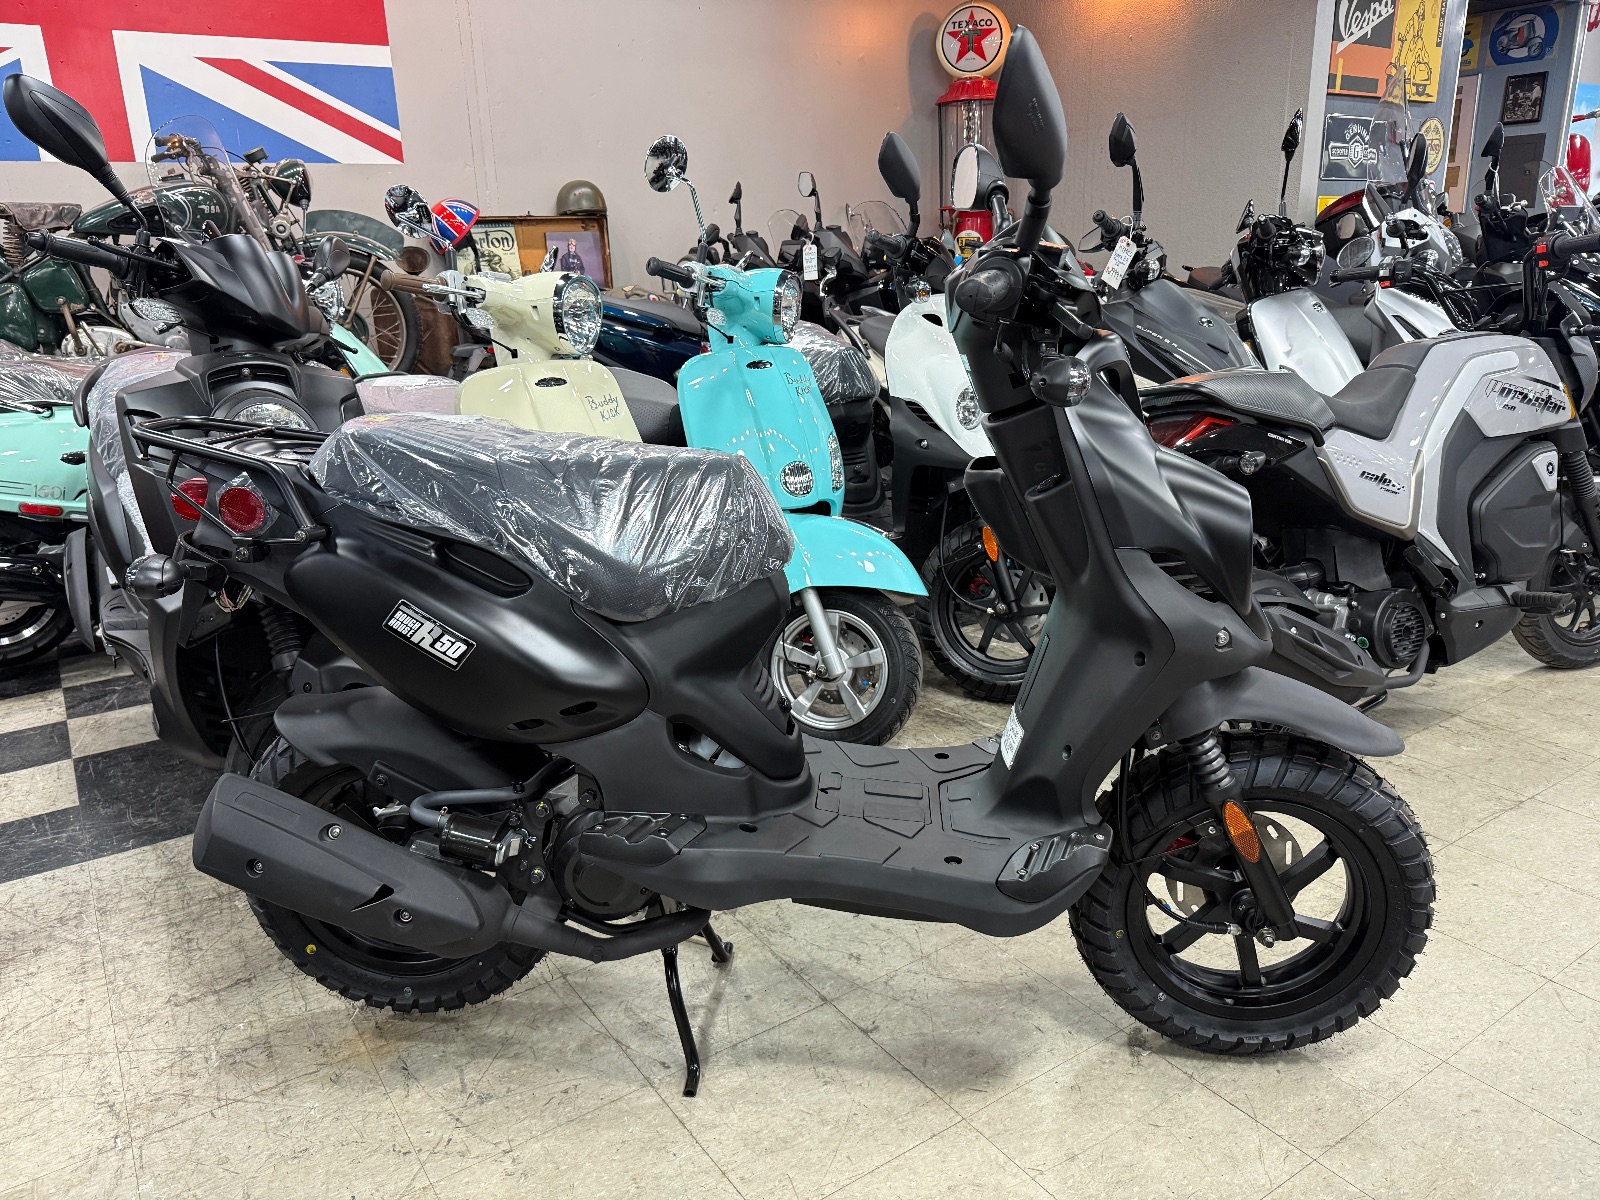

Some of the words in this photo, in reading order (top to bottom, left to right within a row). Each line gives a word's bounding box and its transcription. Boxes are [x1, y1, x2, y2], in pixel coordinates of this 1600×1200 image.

[952, 19, 993, 29] TEXACO
[1336, 0, 1394, 54] Vespa
[204, 205, 220, 213] BSA
[784, 372, 811, 386] Buddy
[584, 393, 619, 411] Buddy
[34, 484, 66, 500] 150i
[387, 617, 415, 638] HOUSE
[393, 610, 422, 631] ROUGH
[433, 634, 468, 659] 50
